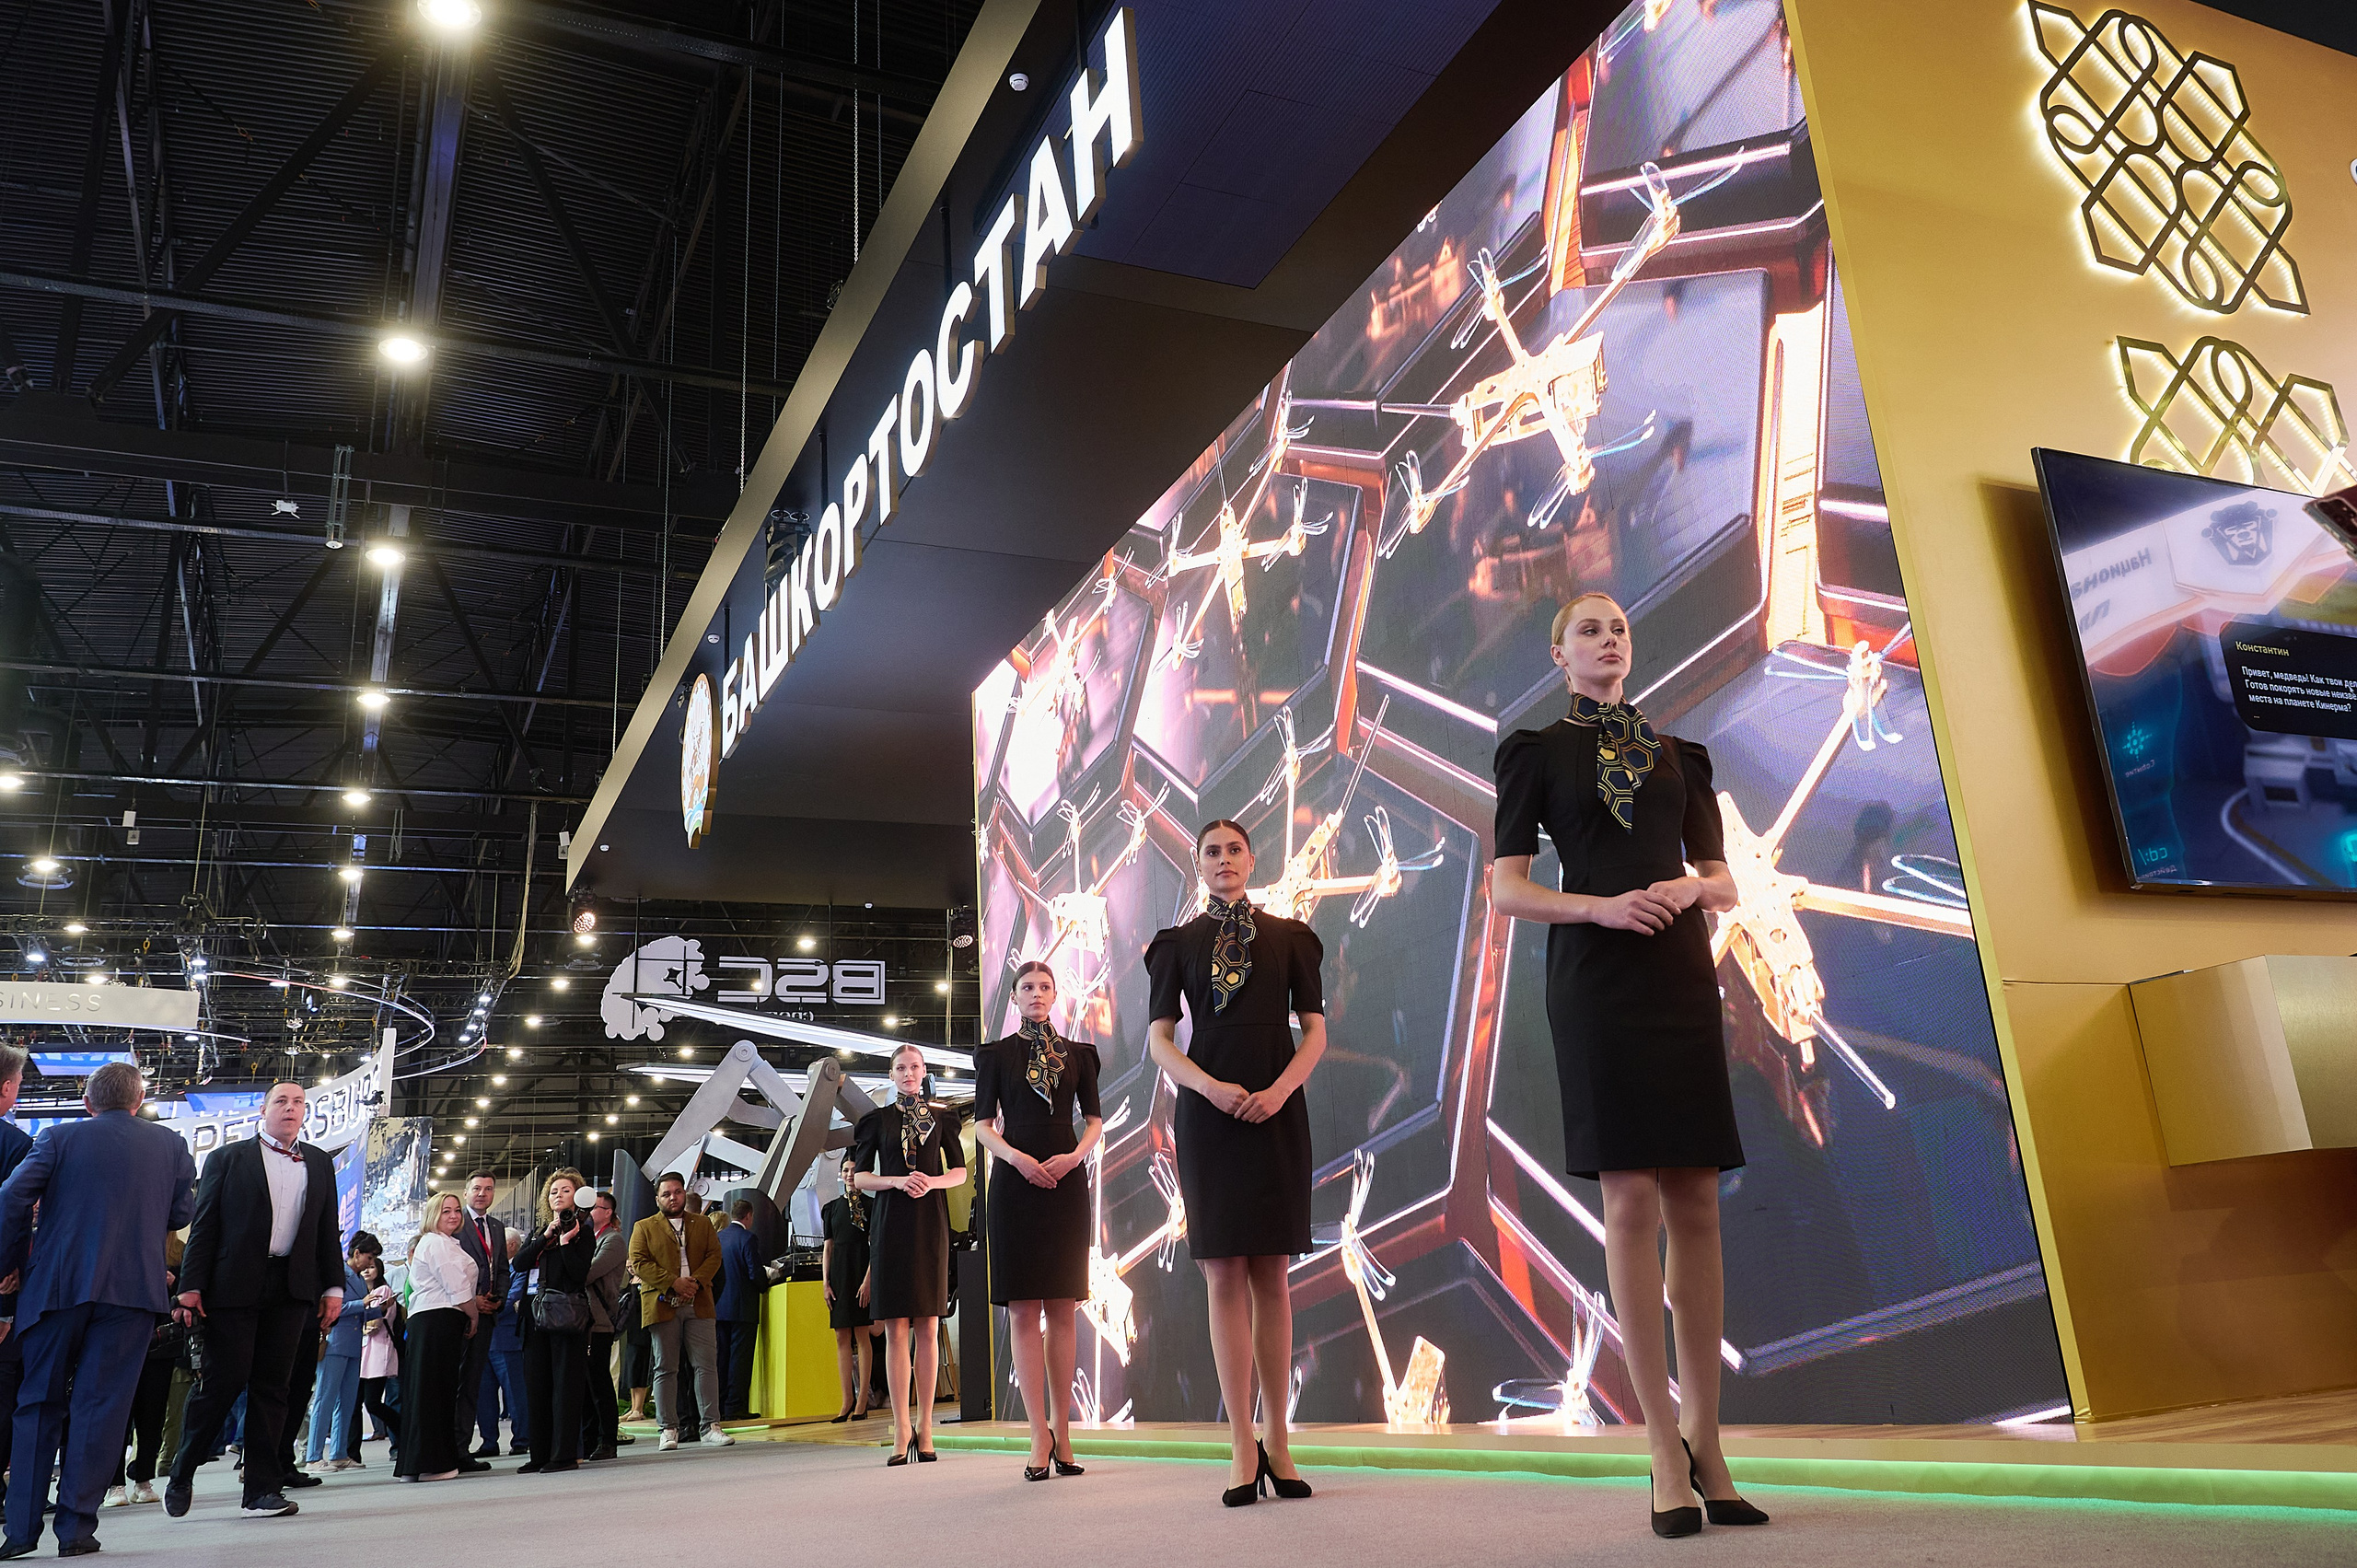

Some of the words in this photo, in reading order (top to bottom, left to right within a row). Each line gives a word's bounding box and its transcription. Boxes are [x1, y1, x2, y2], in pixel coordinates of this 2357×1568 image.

[722, 6, 1139, 759] БАШКОРТОСТАН
[2235, 641, 2290, 656] Константин
[2241, 666, 2273, 680] Привет,
[2273, 671, 2309, 683] медведь!
[2309, 673, 2325, 684] Как
[2325, 678, 2343, 687] твои
[2245, 679, 2269, 691] Готов
[2269, 683, 2305, 695] покорять
[2305, 688, 2330, 697] новые
[2248, 694, 2272, 704] места
[2272, 697, 2283, 705] на
[2283, 698, 2315, 708] планете
[2315, 700, 2351, 713] Кинерма?
